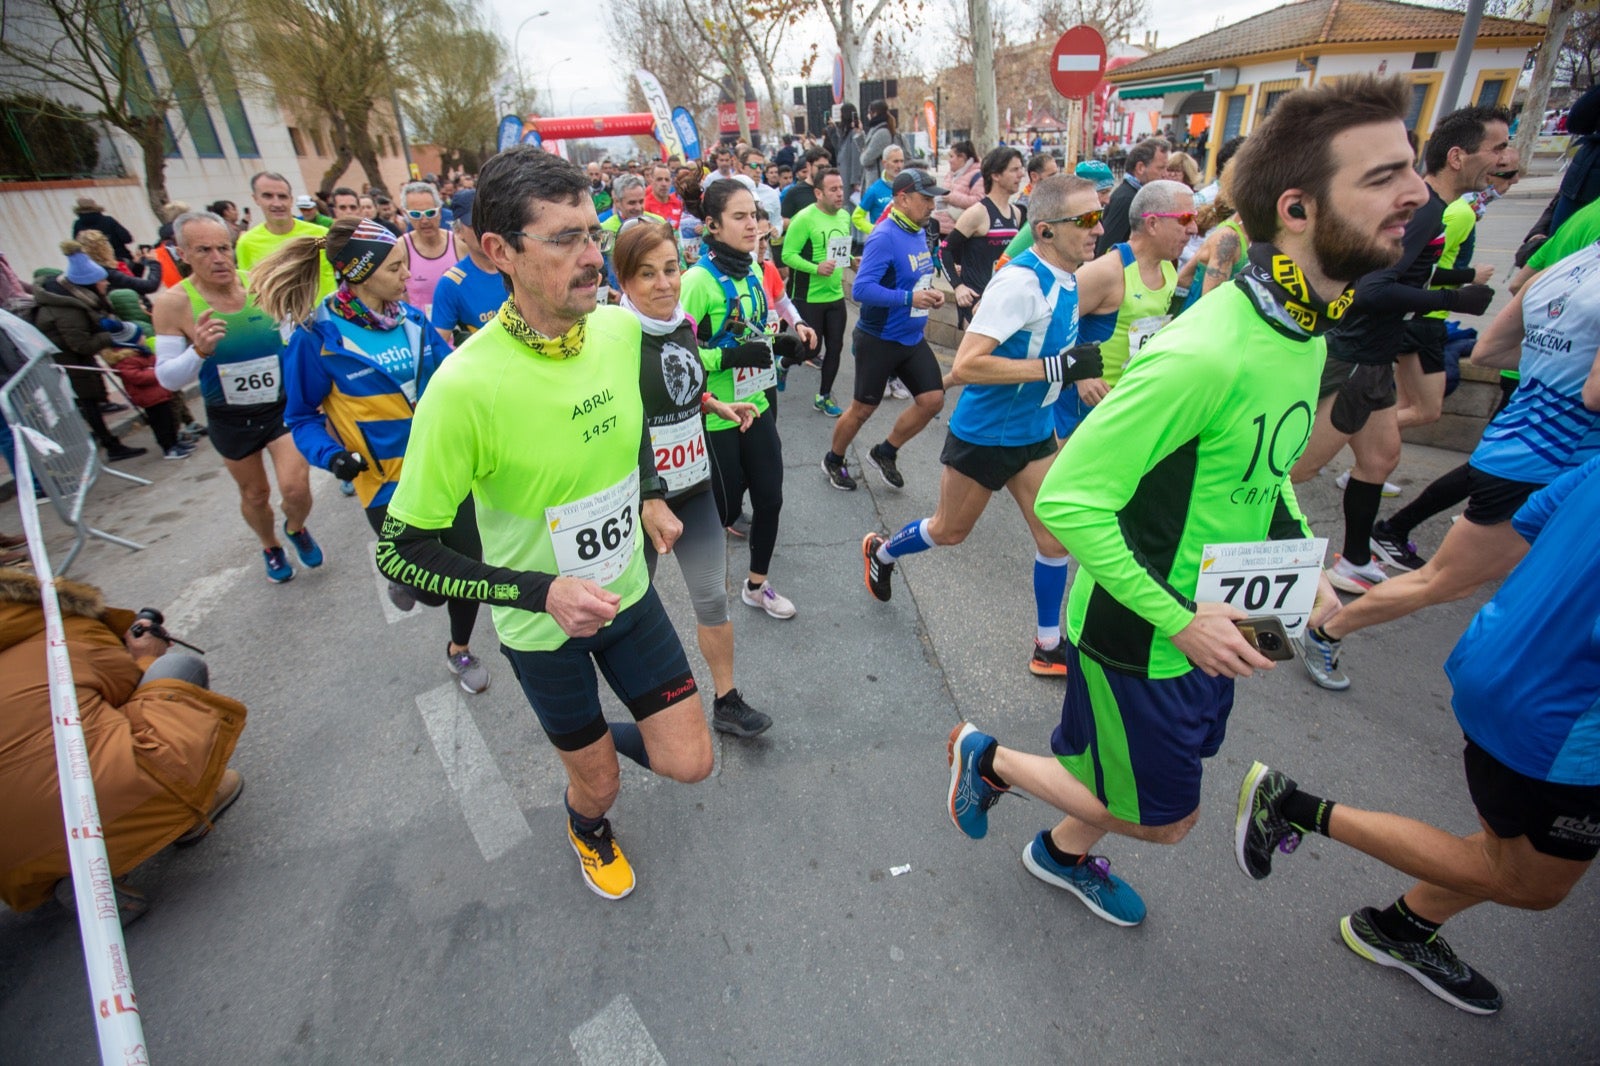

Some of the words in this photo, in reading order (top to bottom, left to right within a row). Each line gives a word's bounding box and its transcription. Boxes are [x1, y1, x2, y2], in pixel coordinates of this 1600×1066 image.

[832, 246, 847, 258] 742
[234, 372, 274, 392] 266
[571, 388, 614, 420] ABRIL
[653, 412, 675, 425] TRAIL
[582, 415, 617, 443] 1957
[655, 434, 704, 471] 2014
[576, 505, 633, 561] 863
[1220, 573, 1299, 611] 707
[88, 856, 116, 921] DEPORTES
[109, 943, 129, 989] Diputación
